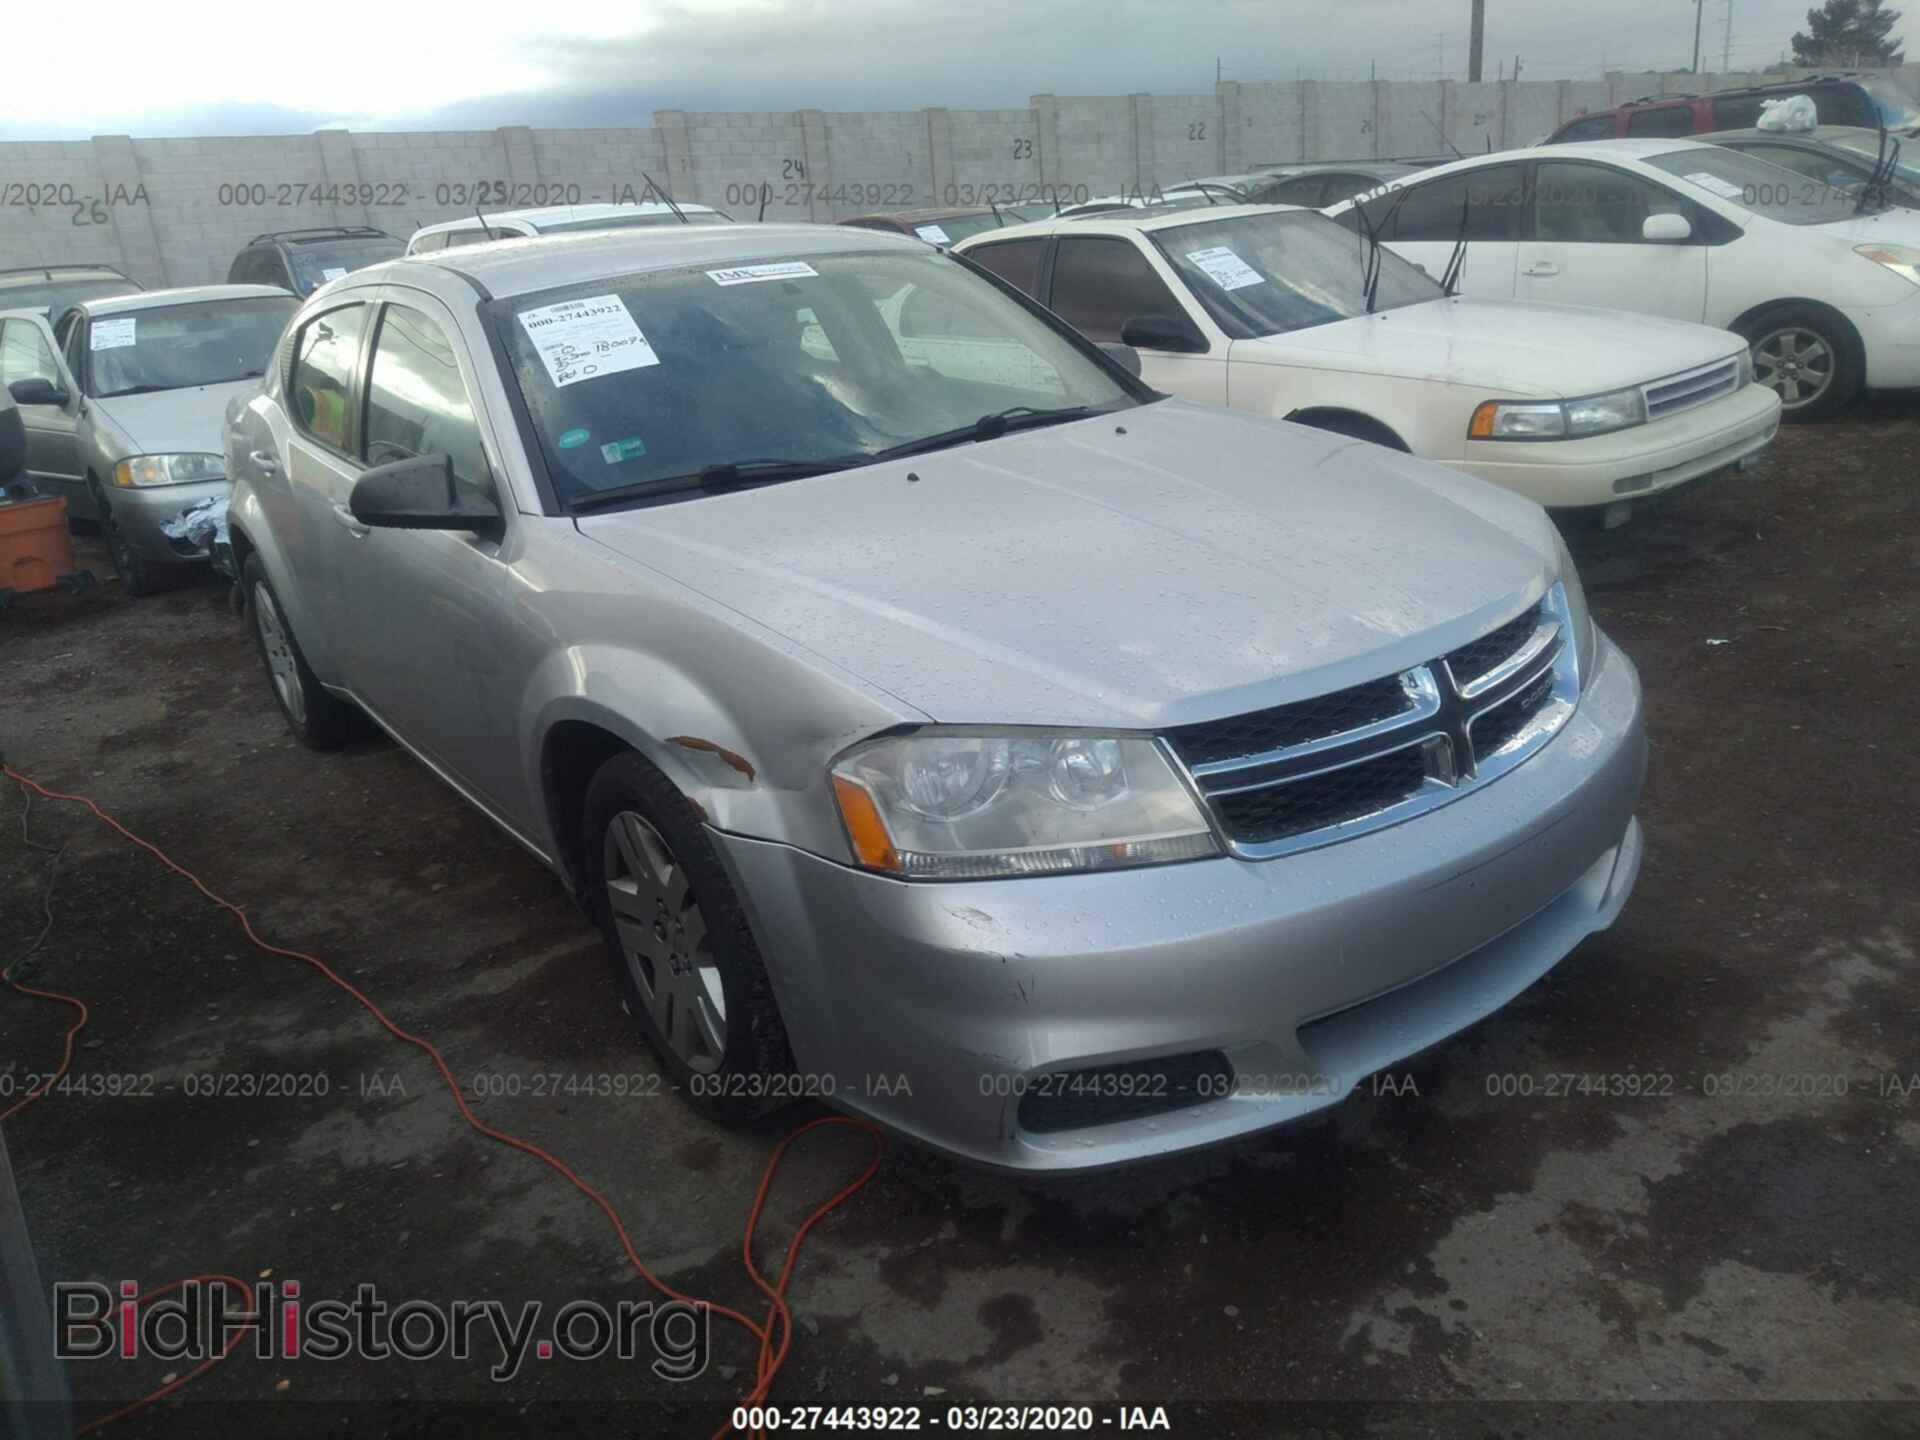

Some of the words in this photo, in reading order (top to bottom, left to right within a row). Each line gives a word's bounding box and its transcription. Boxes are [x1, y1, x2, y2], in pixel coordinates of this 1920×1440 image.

[1188, 121, 1208, 142] 22
[1013, 138, 1034, 160] 23
[782, 159, 806, 180] 24
[72, 198, 110, 227] 26
